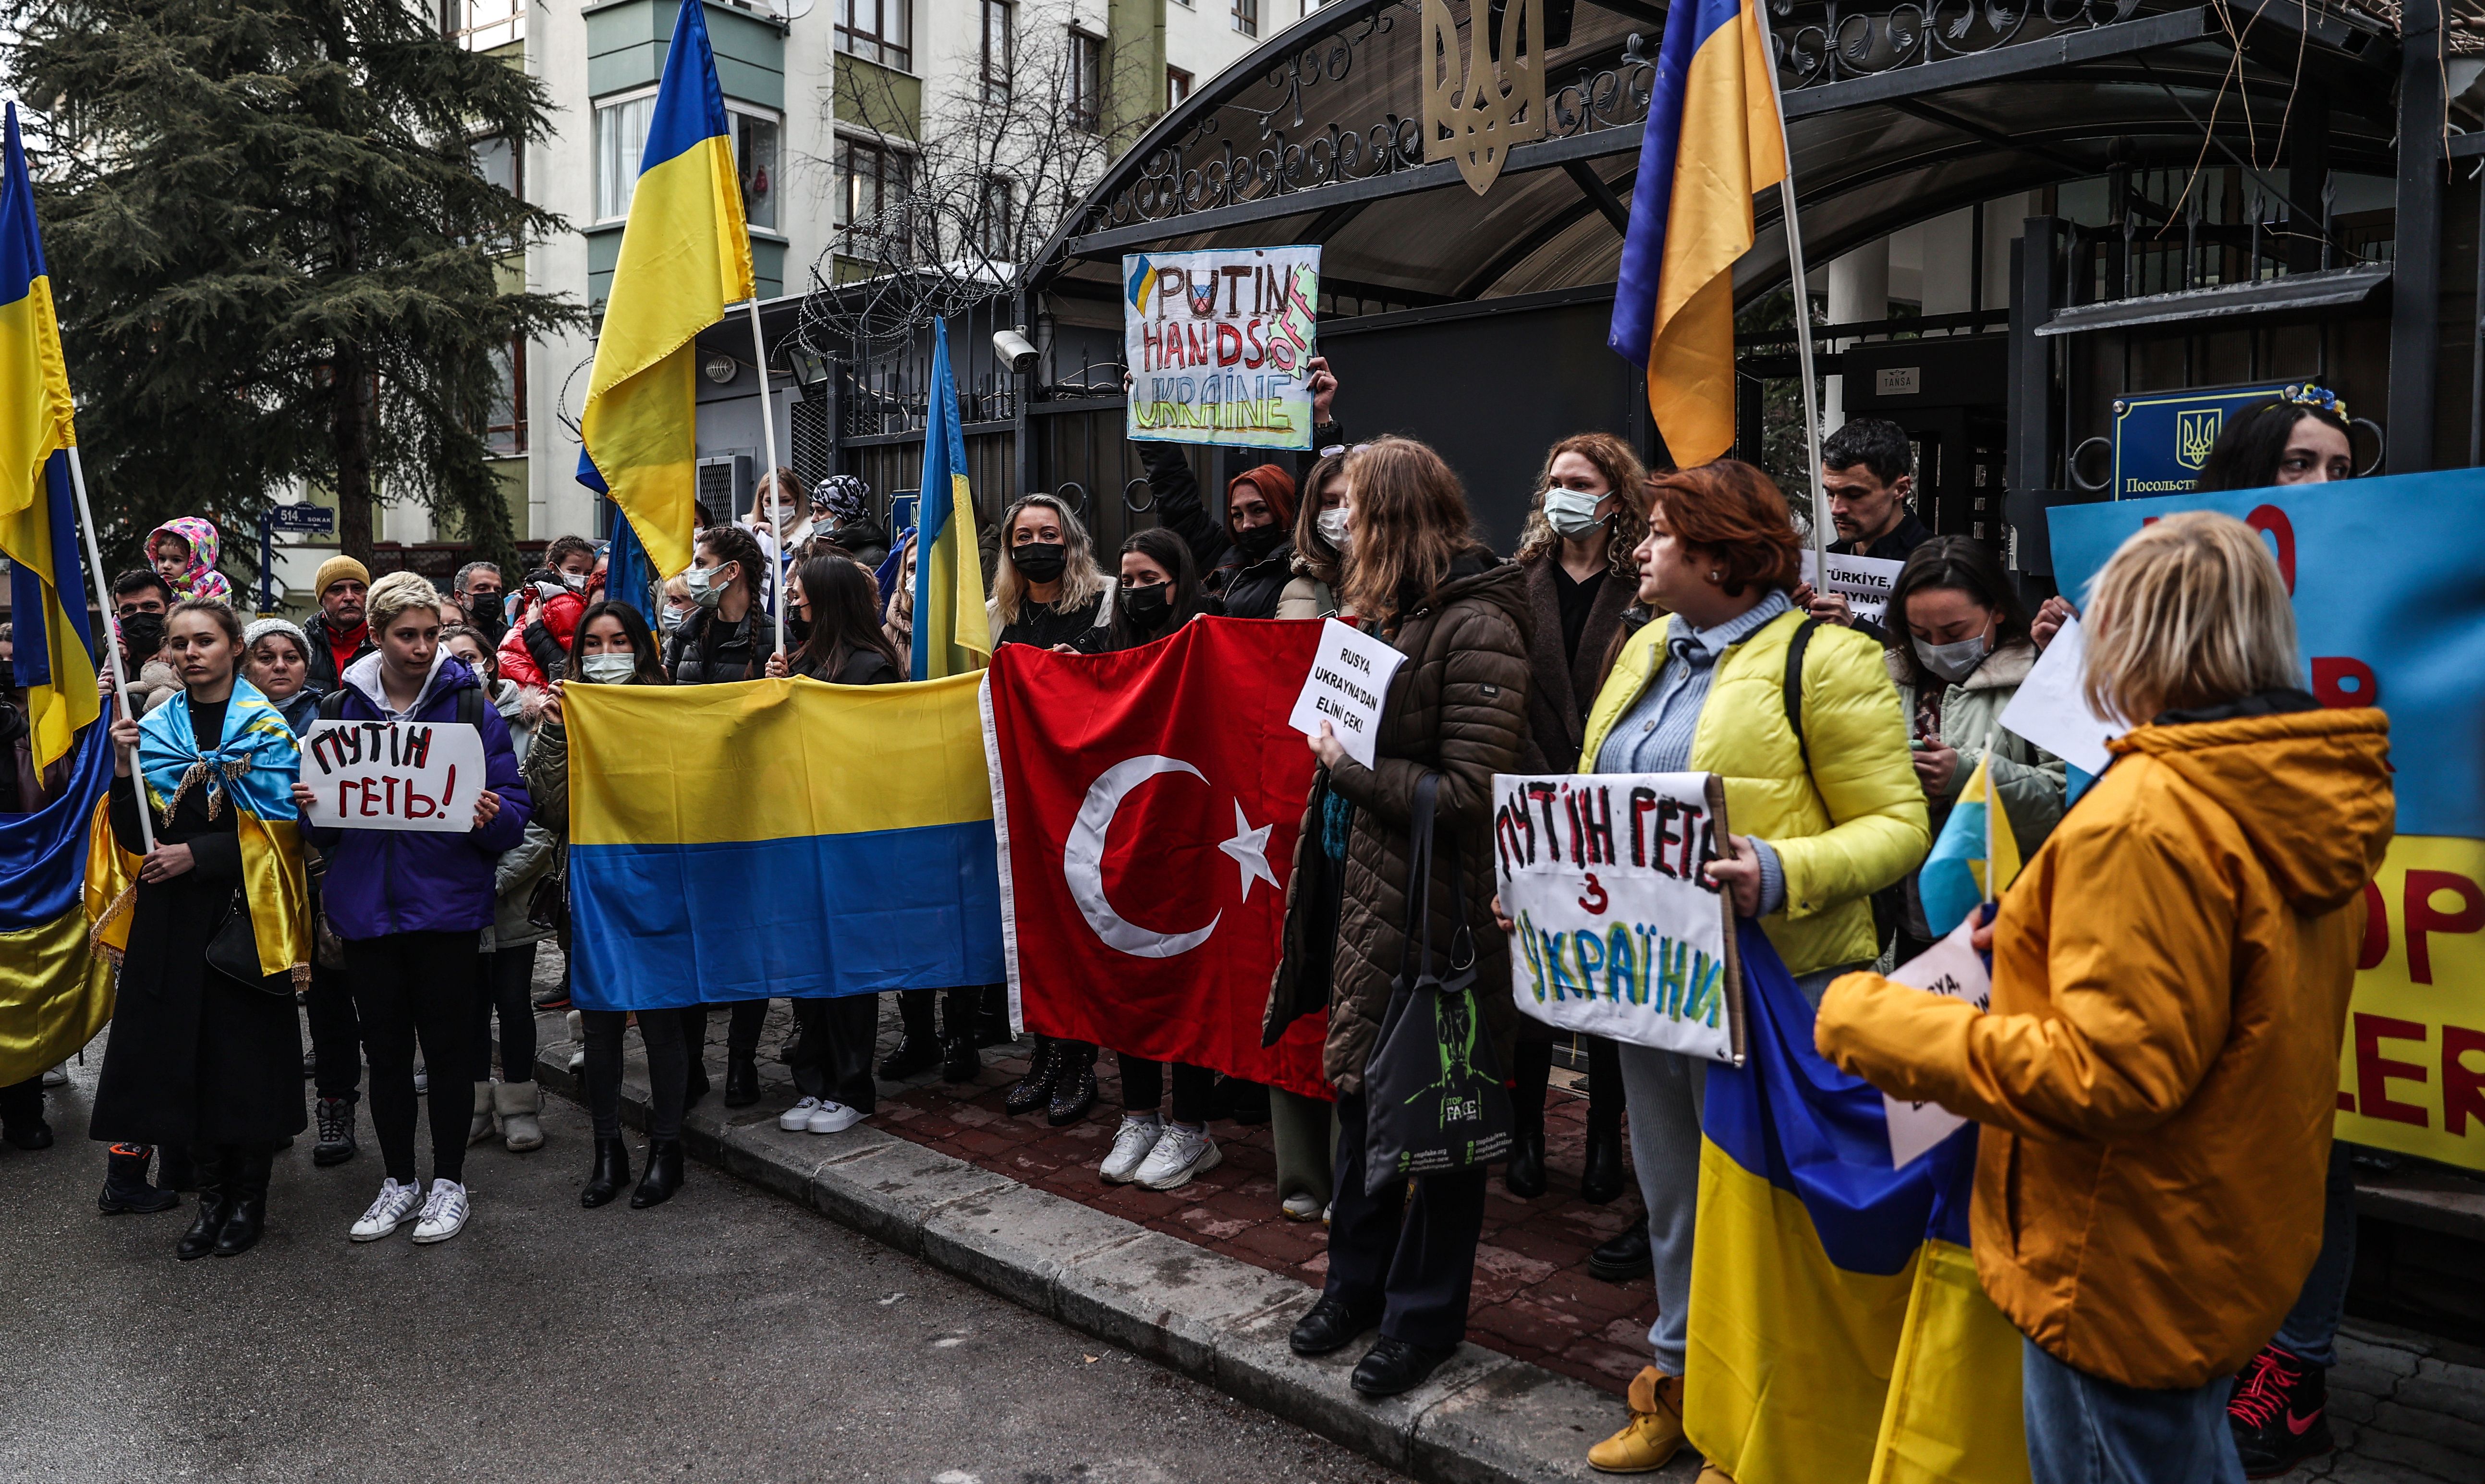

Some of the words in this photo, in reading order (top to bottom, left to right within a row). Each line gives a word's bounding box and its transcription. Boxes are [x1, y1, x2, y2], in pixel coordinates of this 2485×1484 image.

[1142, 318, 1265, 372] HANDS
[1269, 273, 1315, 371] OFF
[1884, 377, 1911, 387] TANSA
[280, 510, 301, 522] 514.
[1827, 568, 1890, 590] ÜRKİYE,
[1340, 647, 1370, 677] RUSYA,
[1315, 666, 1378, 711] UKRAYNA'DAN
[1316, 696, 1344, 720] ELİNİ
[1343, 711, 1364, 733] ÇEK!
[339, 763, 456, 820] ГЕТЬ!
[1515, 909, 1724, 1029] УКРАЇНИ
[1446, 1096, 1462, 1106] STOP
